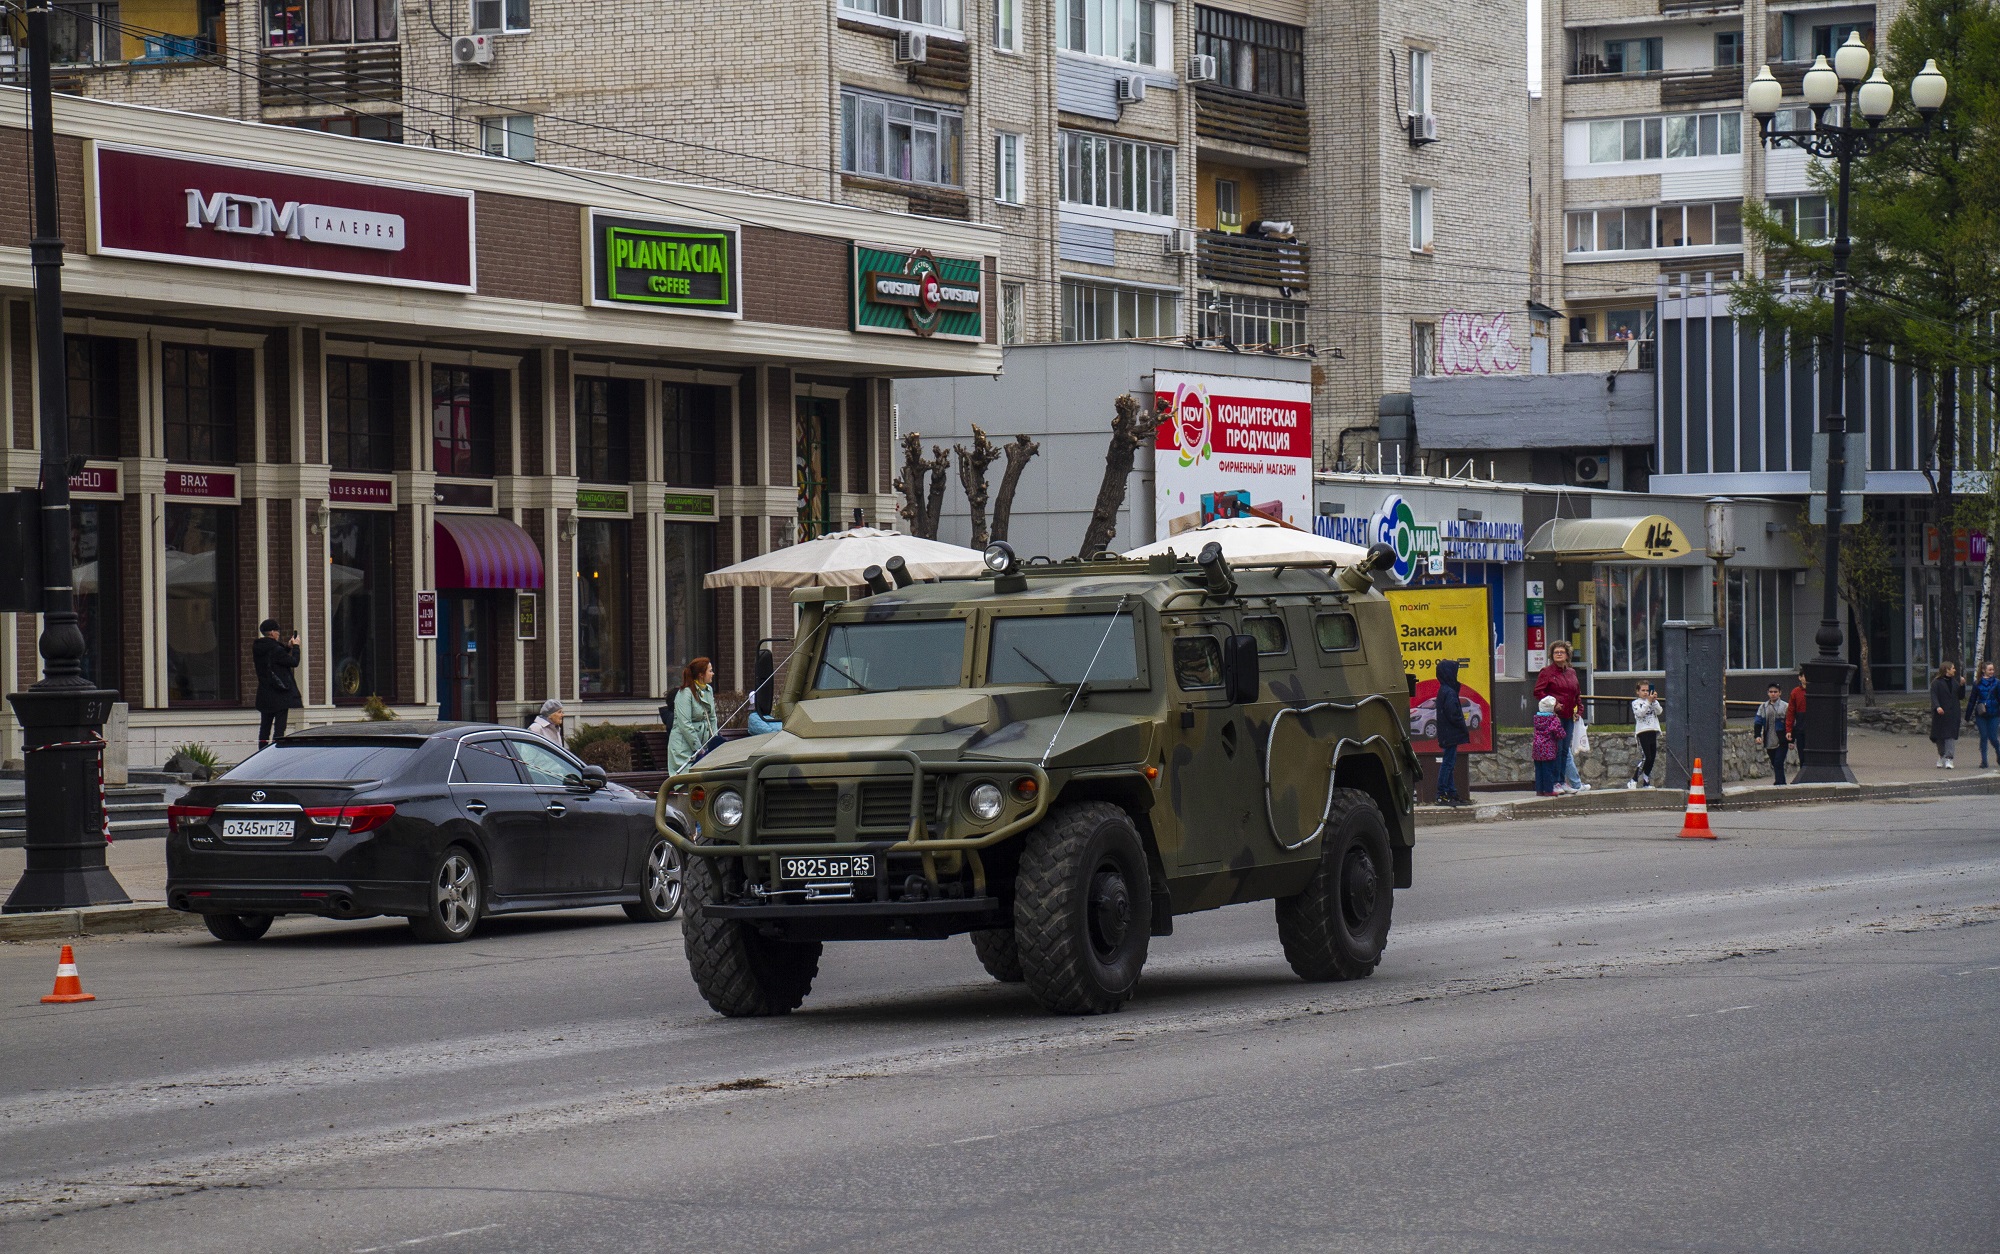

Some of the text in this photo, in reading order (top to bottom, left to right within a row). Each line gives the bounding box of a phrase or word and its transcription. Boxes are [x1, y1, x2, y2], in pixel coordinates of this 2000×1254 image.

[185, 188, 301, 240] MDM
[315, 216, 394, 239] ГАЛЕРЕЯ
[615, 238, 723, 274] PLANTACIA
[648, 275, 691, 295] COFFEE
[877, 280, 980, 303] GUSTAV & GUSTAV
[1183, 406, 1203, 422] KDV
[1217, 404, 1297, 428] КОНДИТЕРСКАЯ
[1226, 428, 1290, 453] ПРОДУКЦИЯ
[1218, 460, 1297, 476] ФИРМЕННЫЙ МАГАЗИН
[180, 474, 208, 487] BRAX
[1447, 519, 1524, 540] МЫ КОНТРОЛИРУЕМ
[1447, 541, 1525, 561] КАЧЕСТВО И ЦЕНЫ
[1400, 603, 1429, 612] maxim
[1401, 624, 1457, 638] Закажи
[1401, 641, 1443, 652] такси
[278, 822, 290, 832] 27
[853, 857, 870, 871] 25
